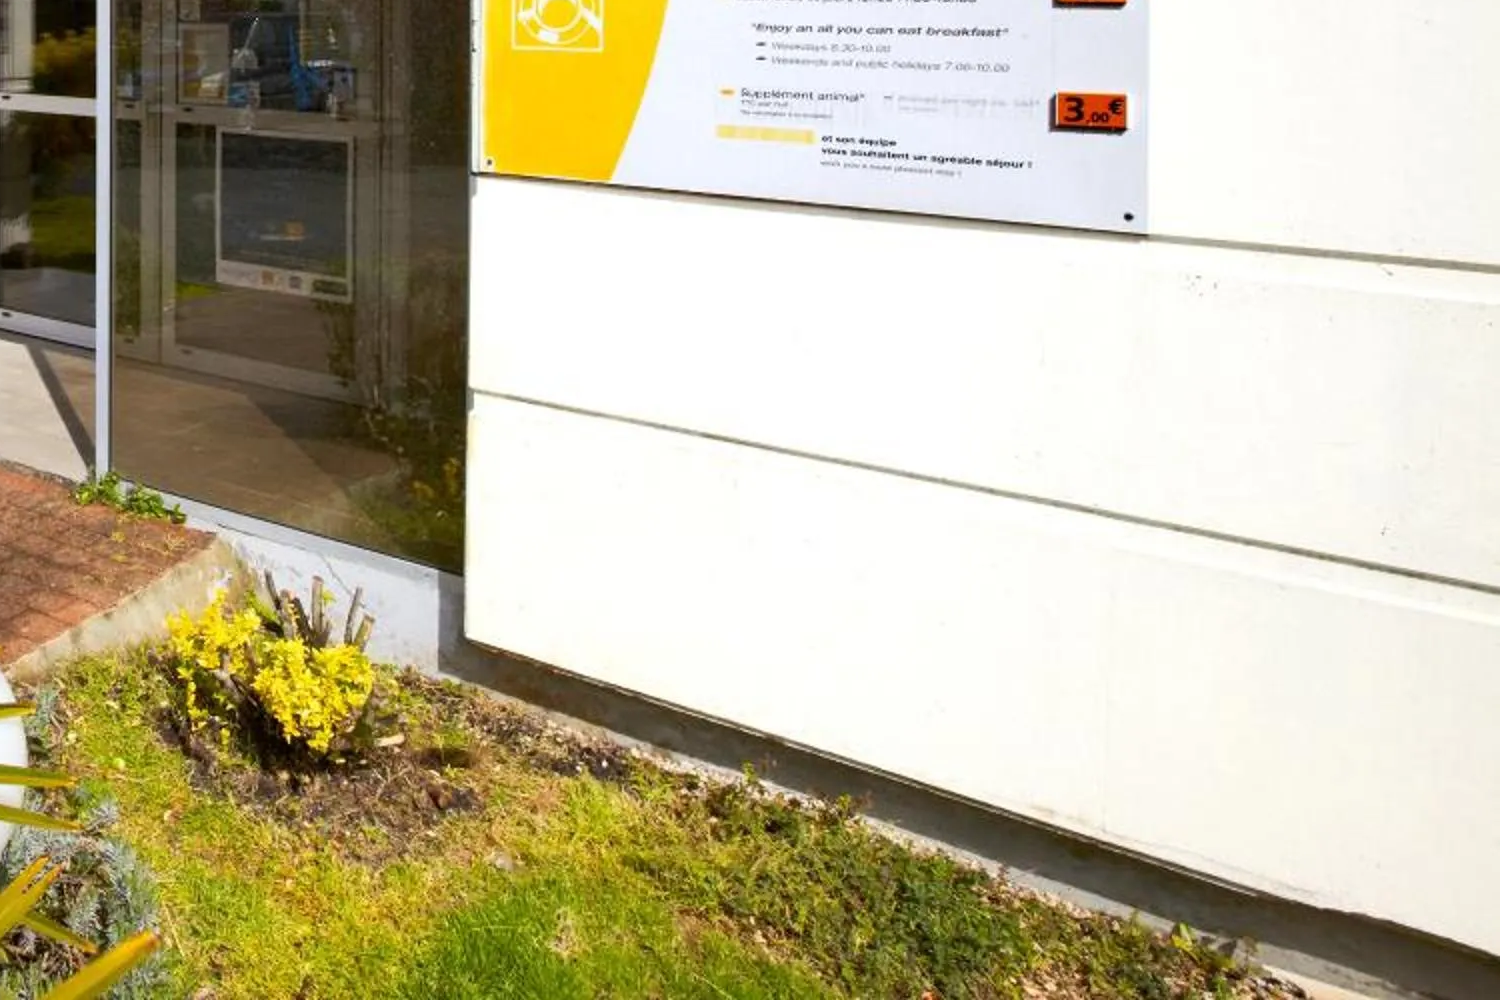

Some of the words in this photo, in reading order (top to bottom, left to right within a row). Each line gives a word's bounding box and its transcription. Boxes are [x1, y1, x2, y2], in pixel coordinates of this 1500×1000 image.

[795, 24, 813, 34] an
[816, 23, 834, 34] all
[836, 25, 863, 36] you
[866, 26, 893, 36] can
[897, 26, 922, 36] eat
[740, 87, 814, 101] Supplément
[821, 134, 833, 144] et
[835, 136, 855, 145] son
[821, 148, 848, 157] vous
[850, 149, 910, 160] souhaitent
[913, 153, 927, 162] un
[931, 153, 982, 166] agréable
[986, 157, 1024, 169] séjour
